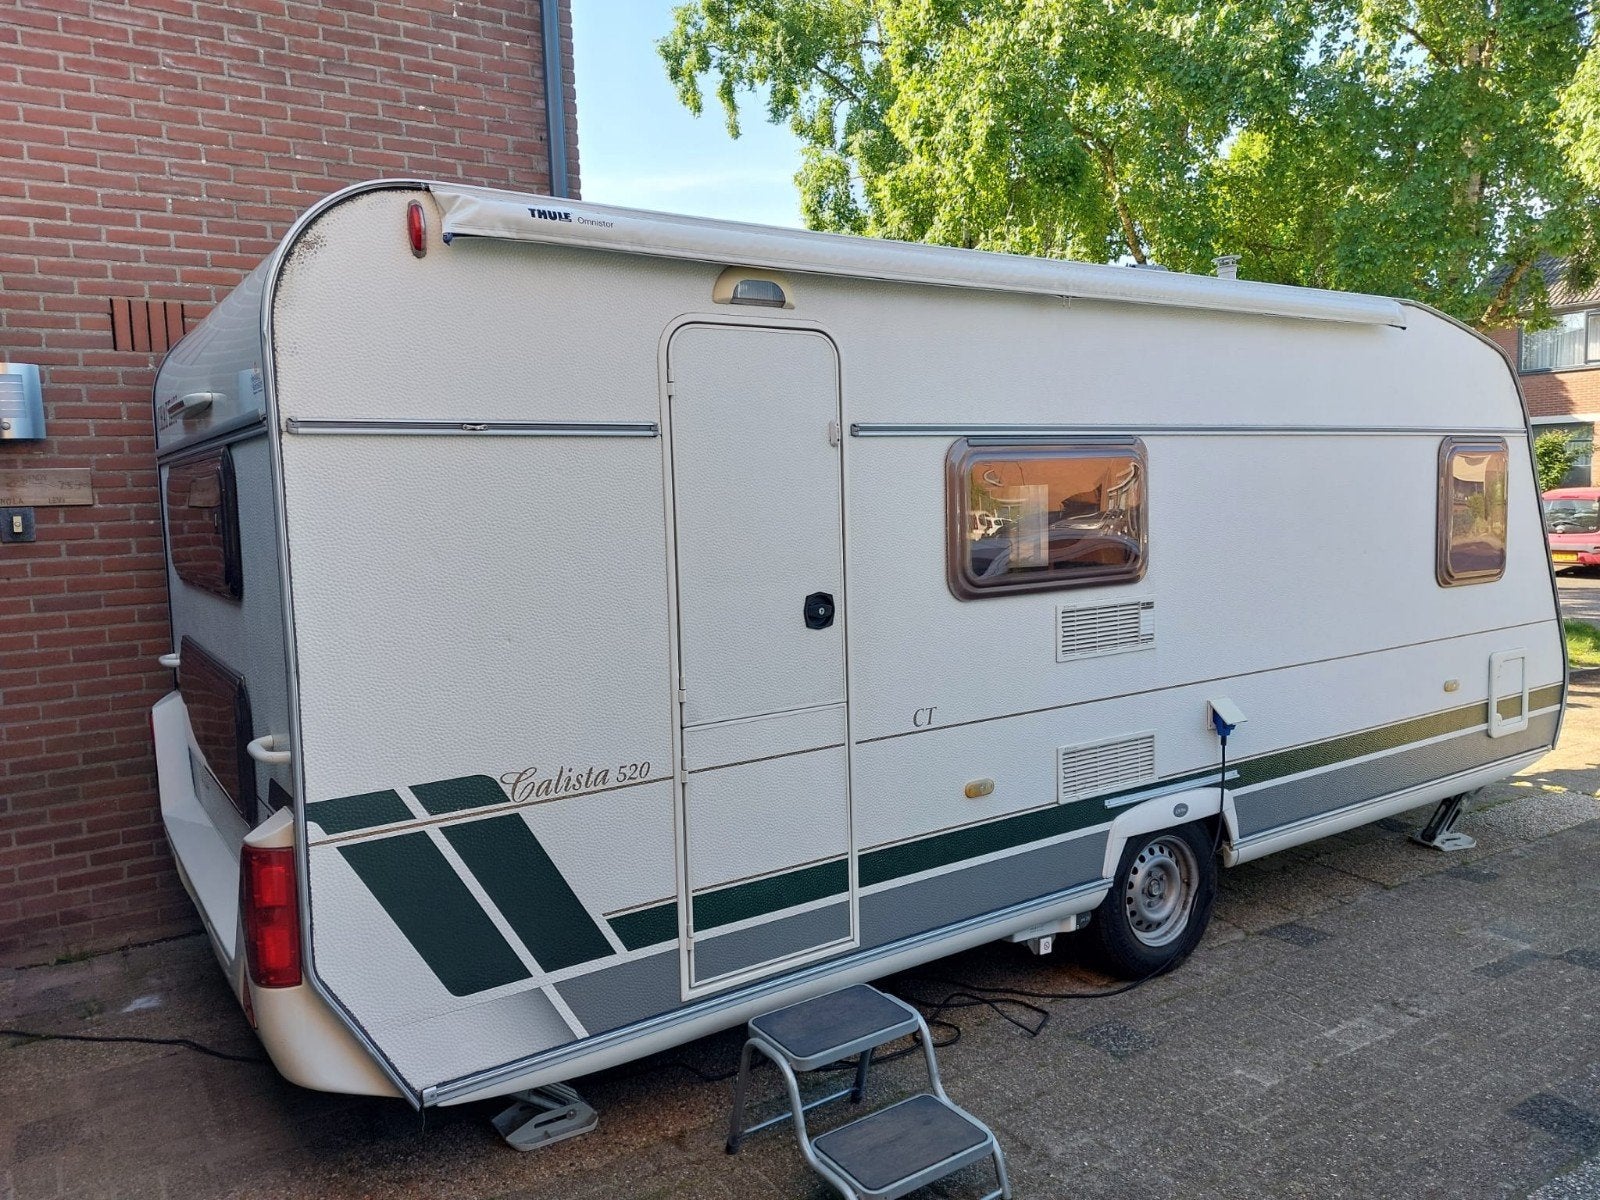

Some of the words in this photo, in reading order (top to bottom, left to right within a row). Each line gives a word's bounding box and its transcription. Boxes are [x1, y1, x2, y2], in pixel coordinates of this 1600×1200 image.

[528, 208, 572, 223] THULE
[577, 216, 614, 228] Omnistor
[913, 706, 938, 727] CT
[500, 765, 610, 803] Calista
[616, 761, 651, 783] 520
